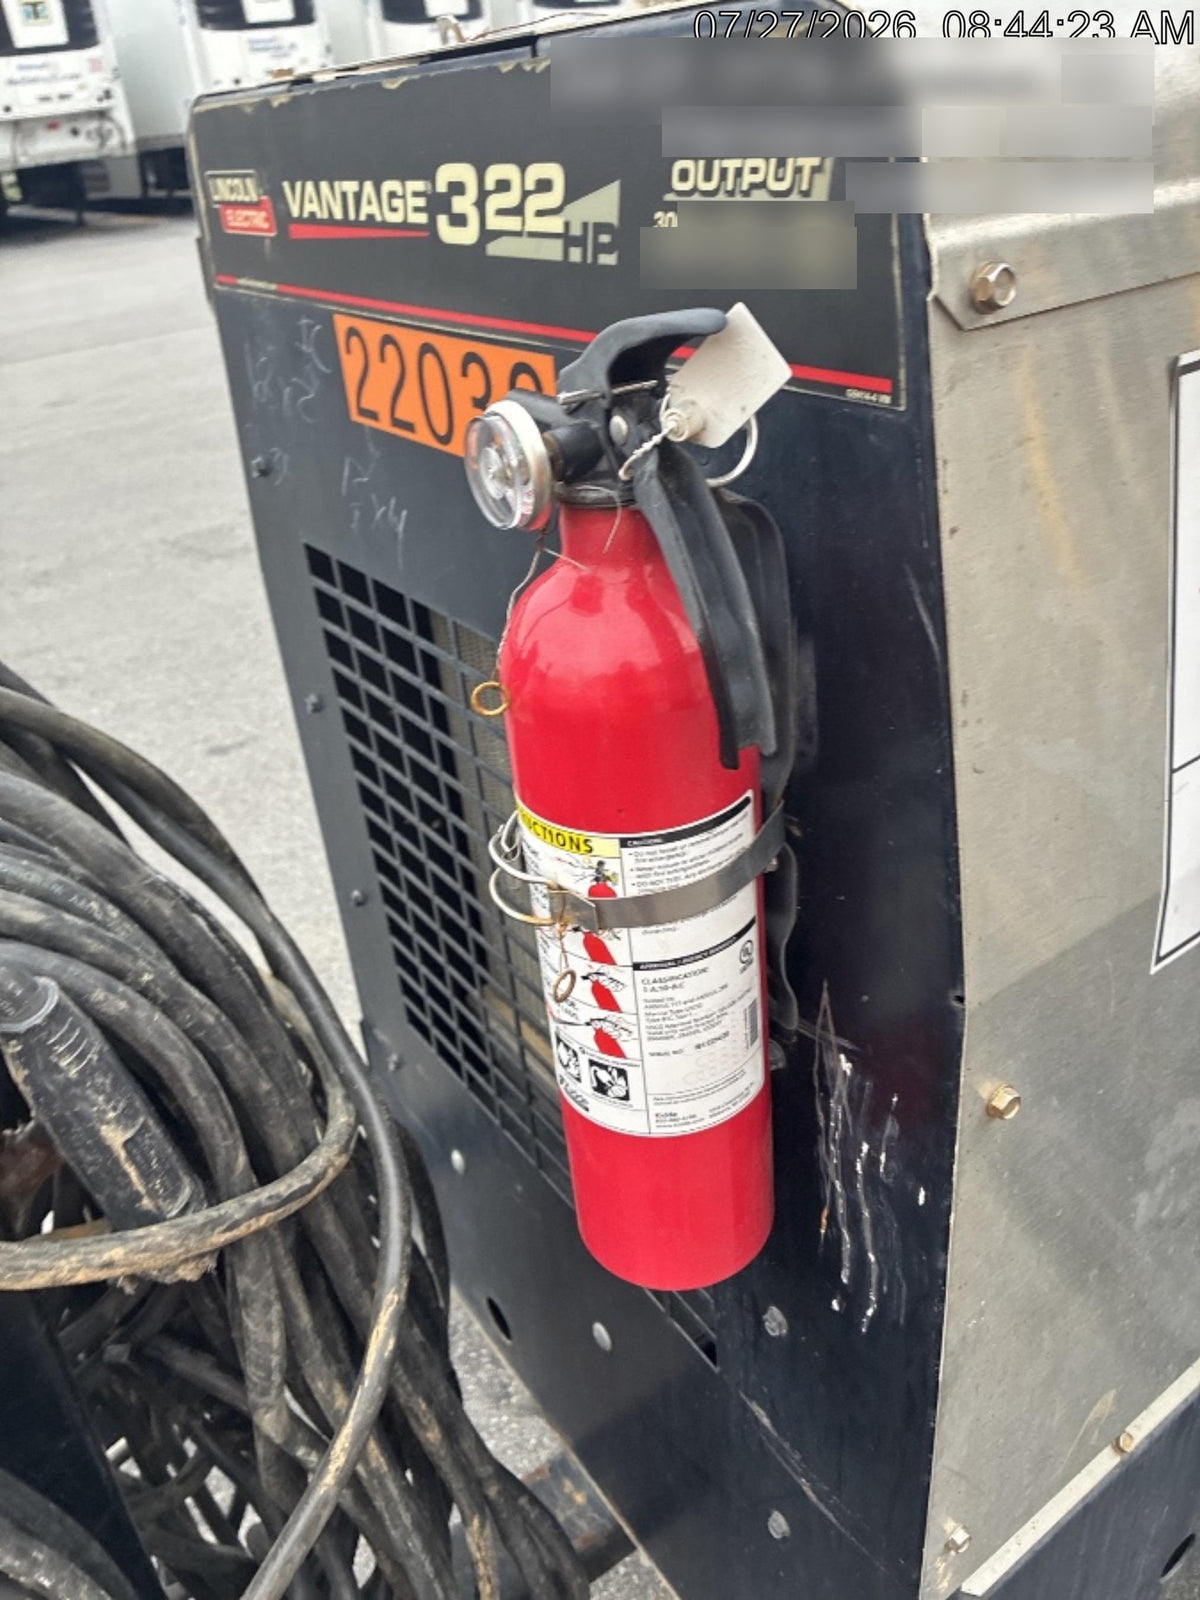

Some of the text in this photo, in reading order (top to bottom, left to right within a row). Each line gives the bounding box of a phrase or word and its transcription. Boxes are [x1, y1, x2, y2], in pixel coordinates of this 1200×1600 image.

[207, 176, 259, 202] LINCOLN
[671, 156, 822, 192] OUTPUT
[224, 208, 270, 230] ELECTRIC
[282, 179, 430, 224] VANTAGE
[435, 162, 566, 246] 322
